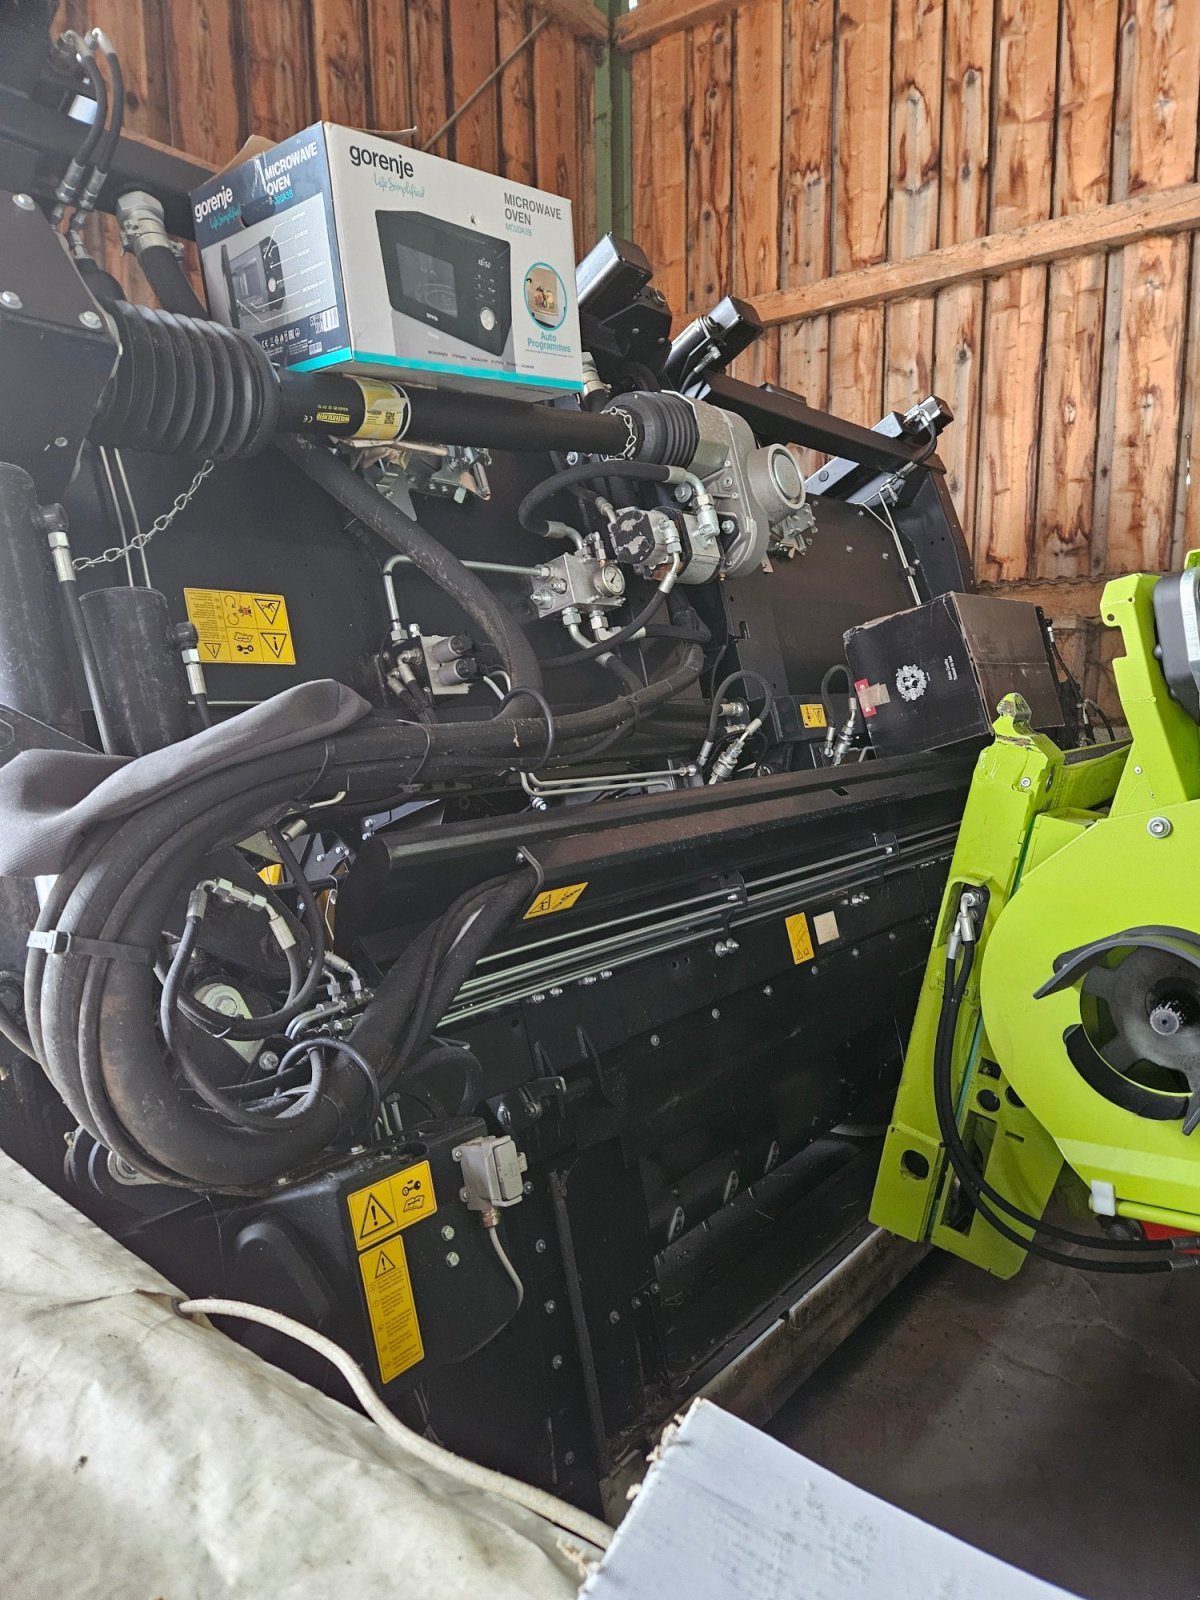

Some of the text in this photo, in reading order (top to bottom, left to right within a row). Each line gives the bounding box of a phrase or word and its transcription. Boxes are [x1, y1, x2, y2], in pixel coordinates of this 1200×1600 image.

[264, 141, 318, 180] MICROWAVE
[349, 145, 414, 179] gorenje
[267, 174, 291, 195] OVEN
[194, 186, 233, 222] gorenje
[504, 192, 562, 220] MICROWAVE
[505, 208, 531, 225] OVEN
[527, 337, 572, 352] Programmes
[541, 331, 557, 342] Auto
